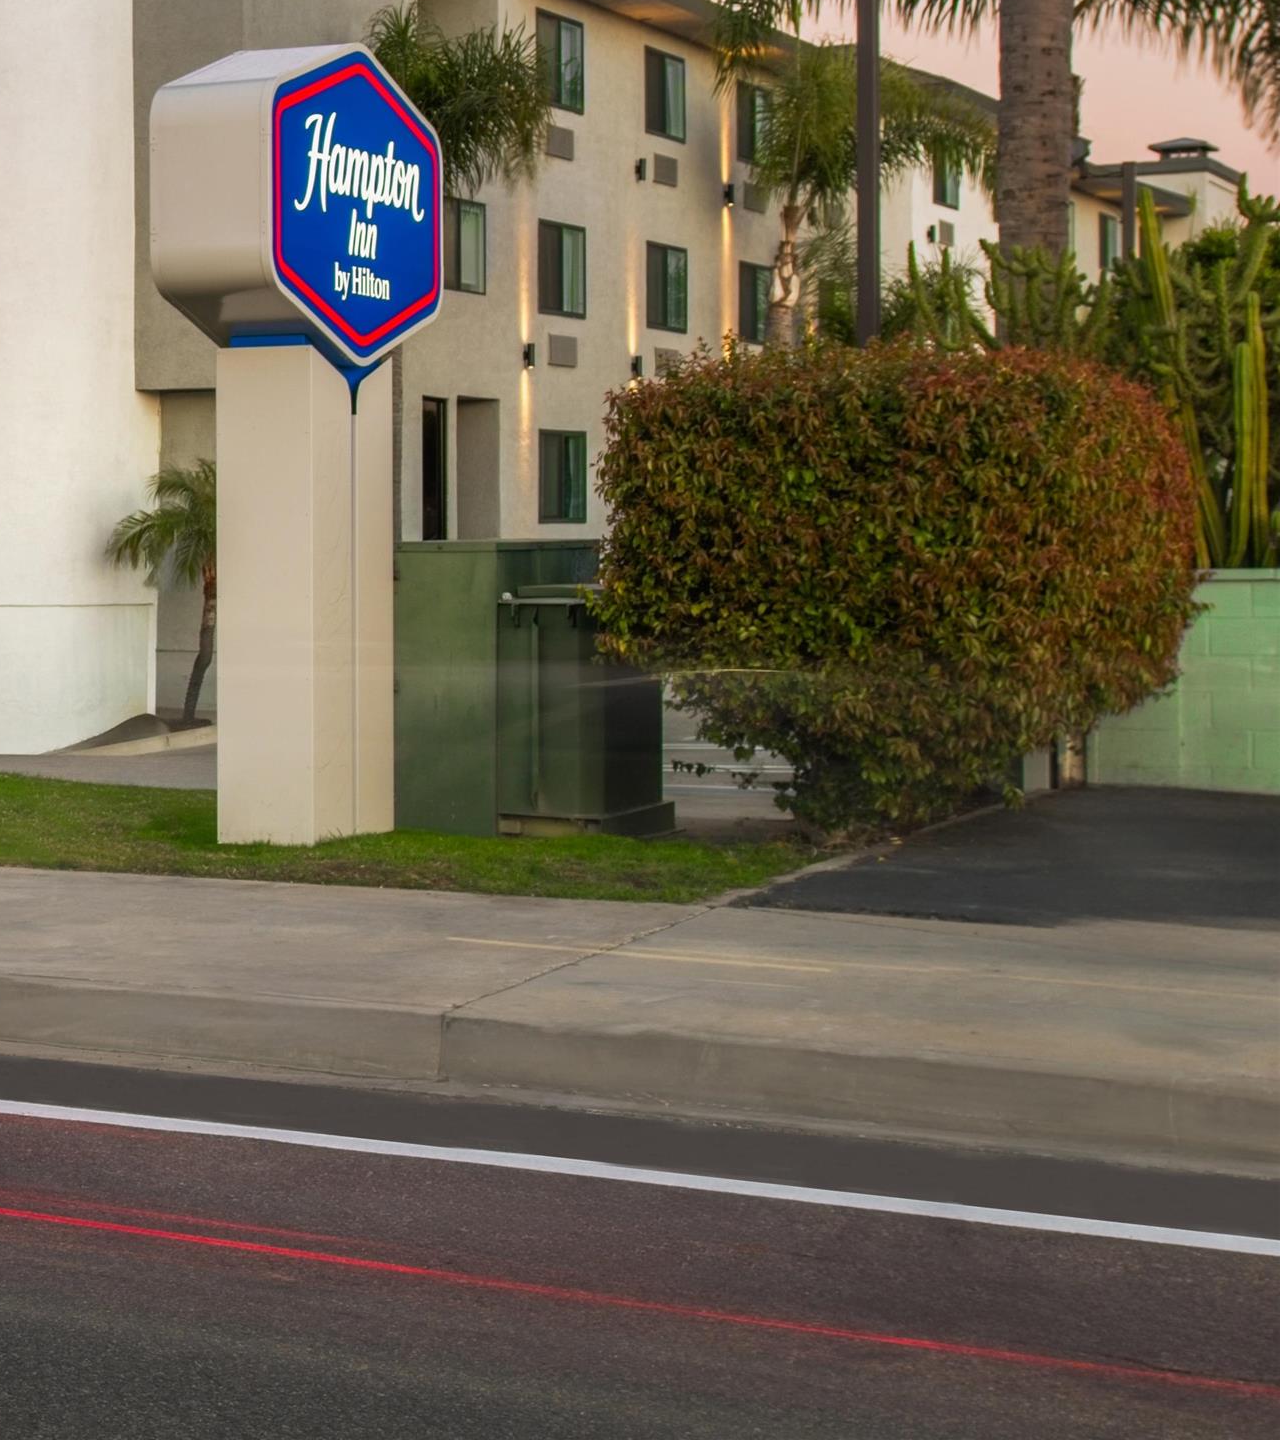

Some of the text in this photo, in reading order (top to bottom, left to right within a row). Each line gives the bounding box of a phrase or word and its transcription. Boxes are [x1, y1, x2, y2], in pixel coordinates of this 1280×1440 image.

[294, 111, 424, 223] Hampton
[348, 208, 378, 260] Inn
[334, 261, 390, 301] by Hilton
